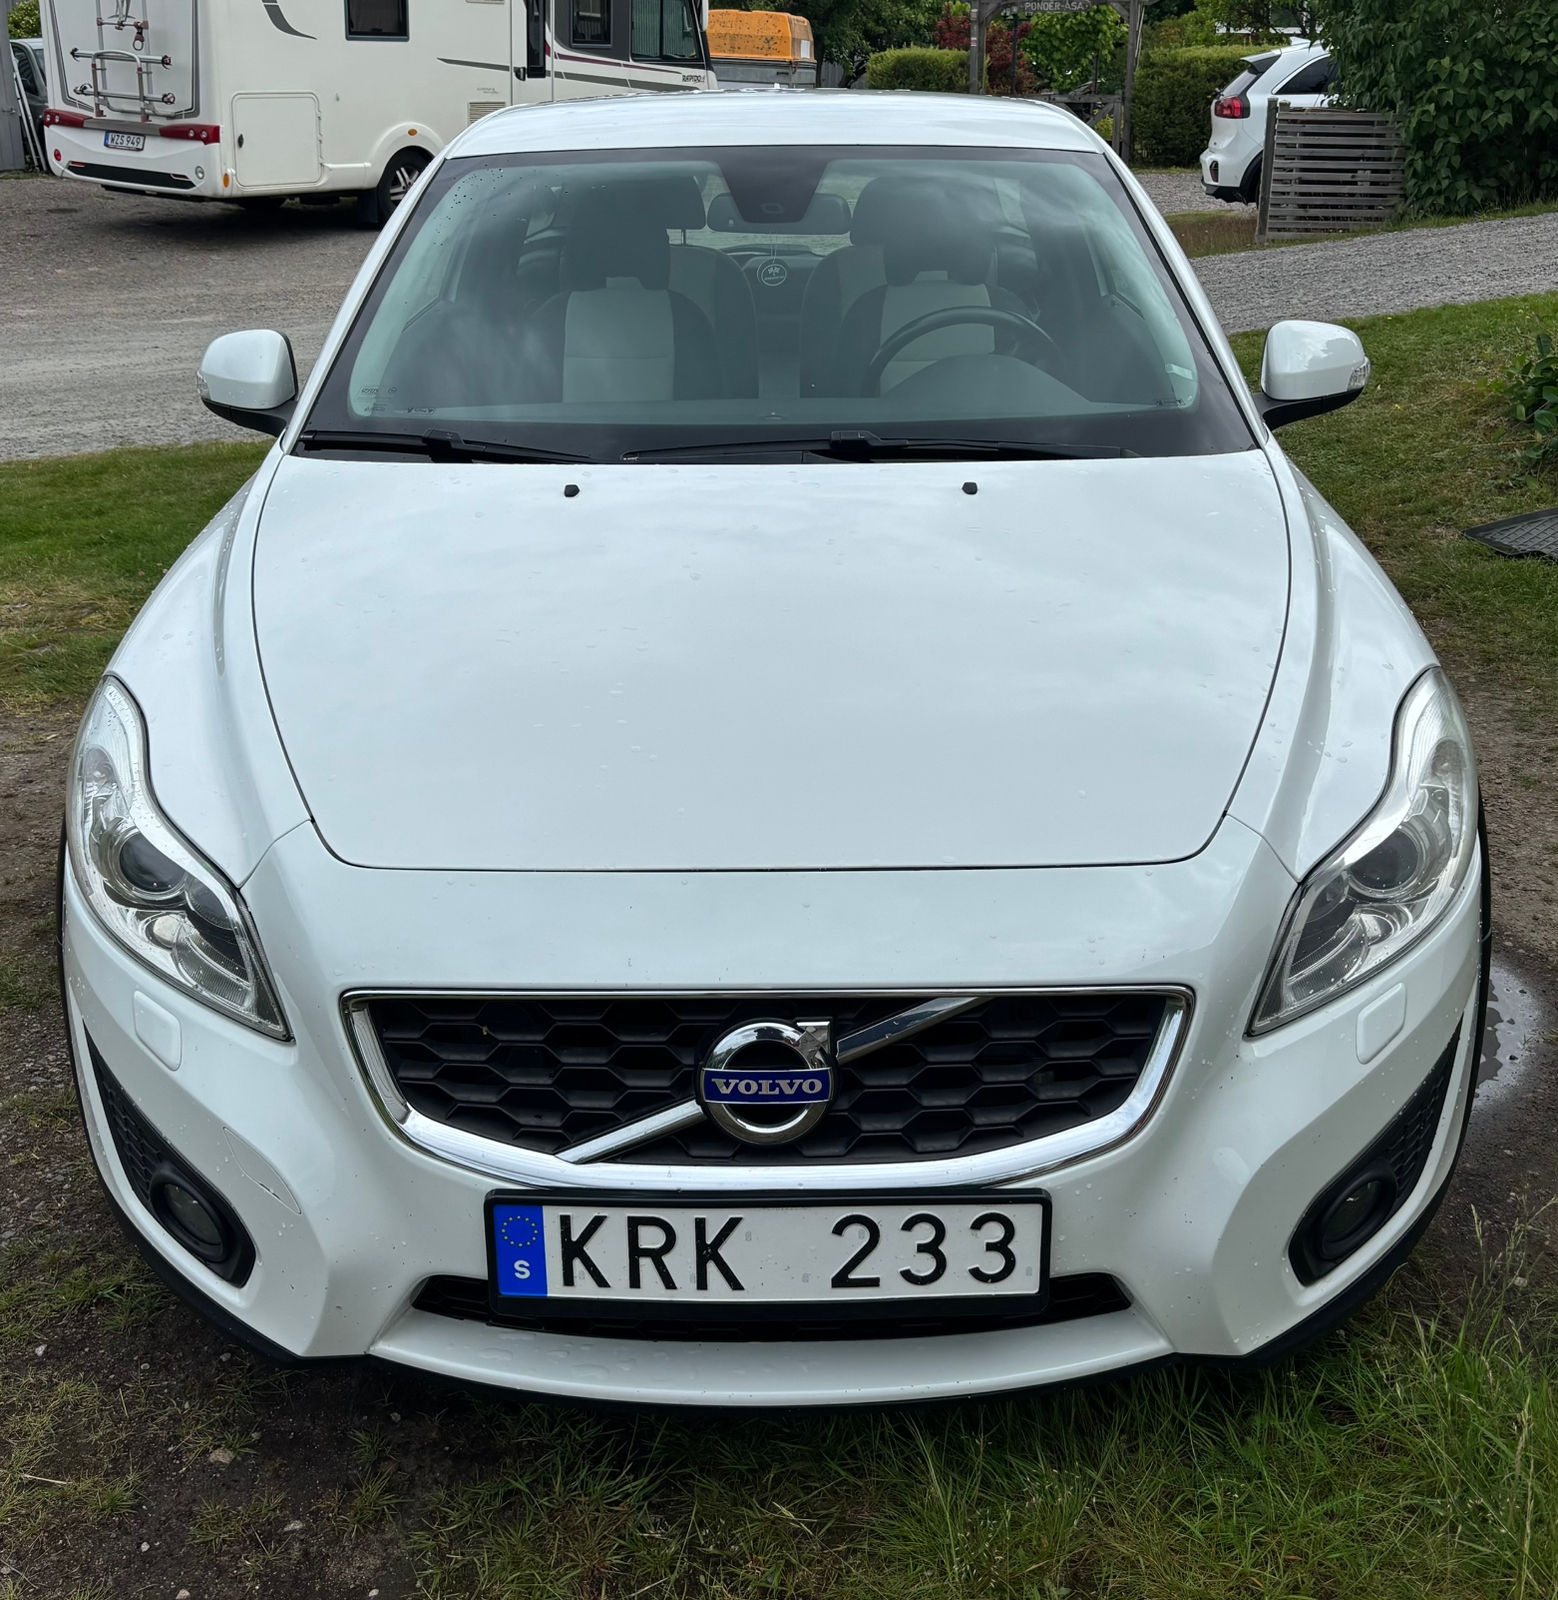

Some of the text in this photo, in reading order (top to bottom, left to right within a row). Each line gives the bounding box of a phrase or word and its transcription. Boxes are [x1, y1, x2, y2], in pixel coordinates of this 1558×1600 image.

[110, 134, 141, 147] WZS 949
[711, 1078, 823, 1095] VOLVO
[559, 1212, 1017, 1291] KRK 233
[514, 1259, 531, 1279] S
